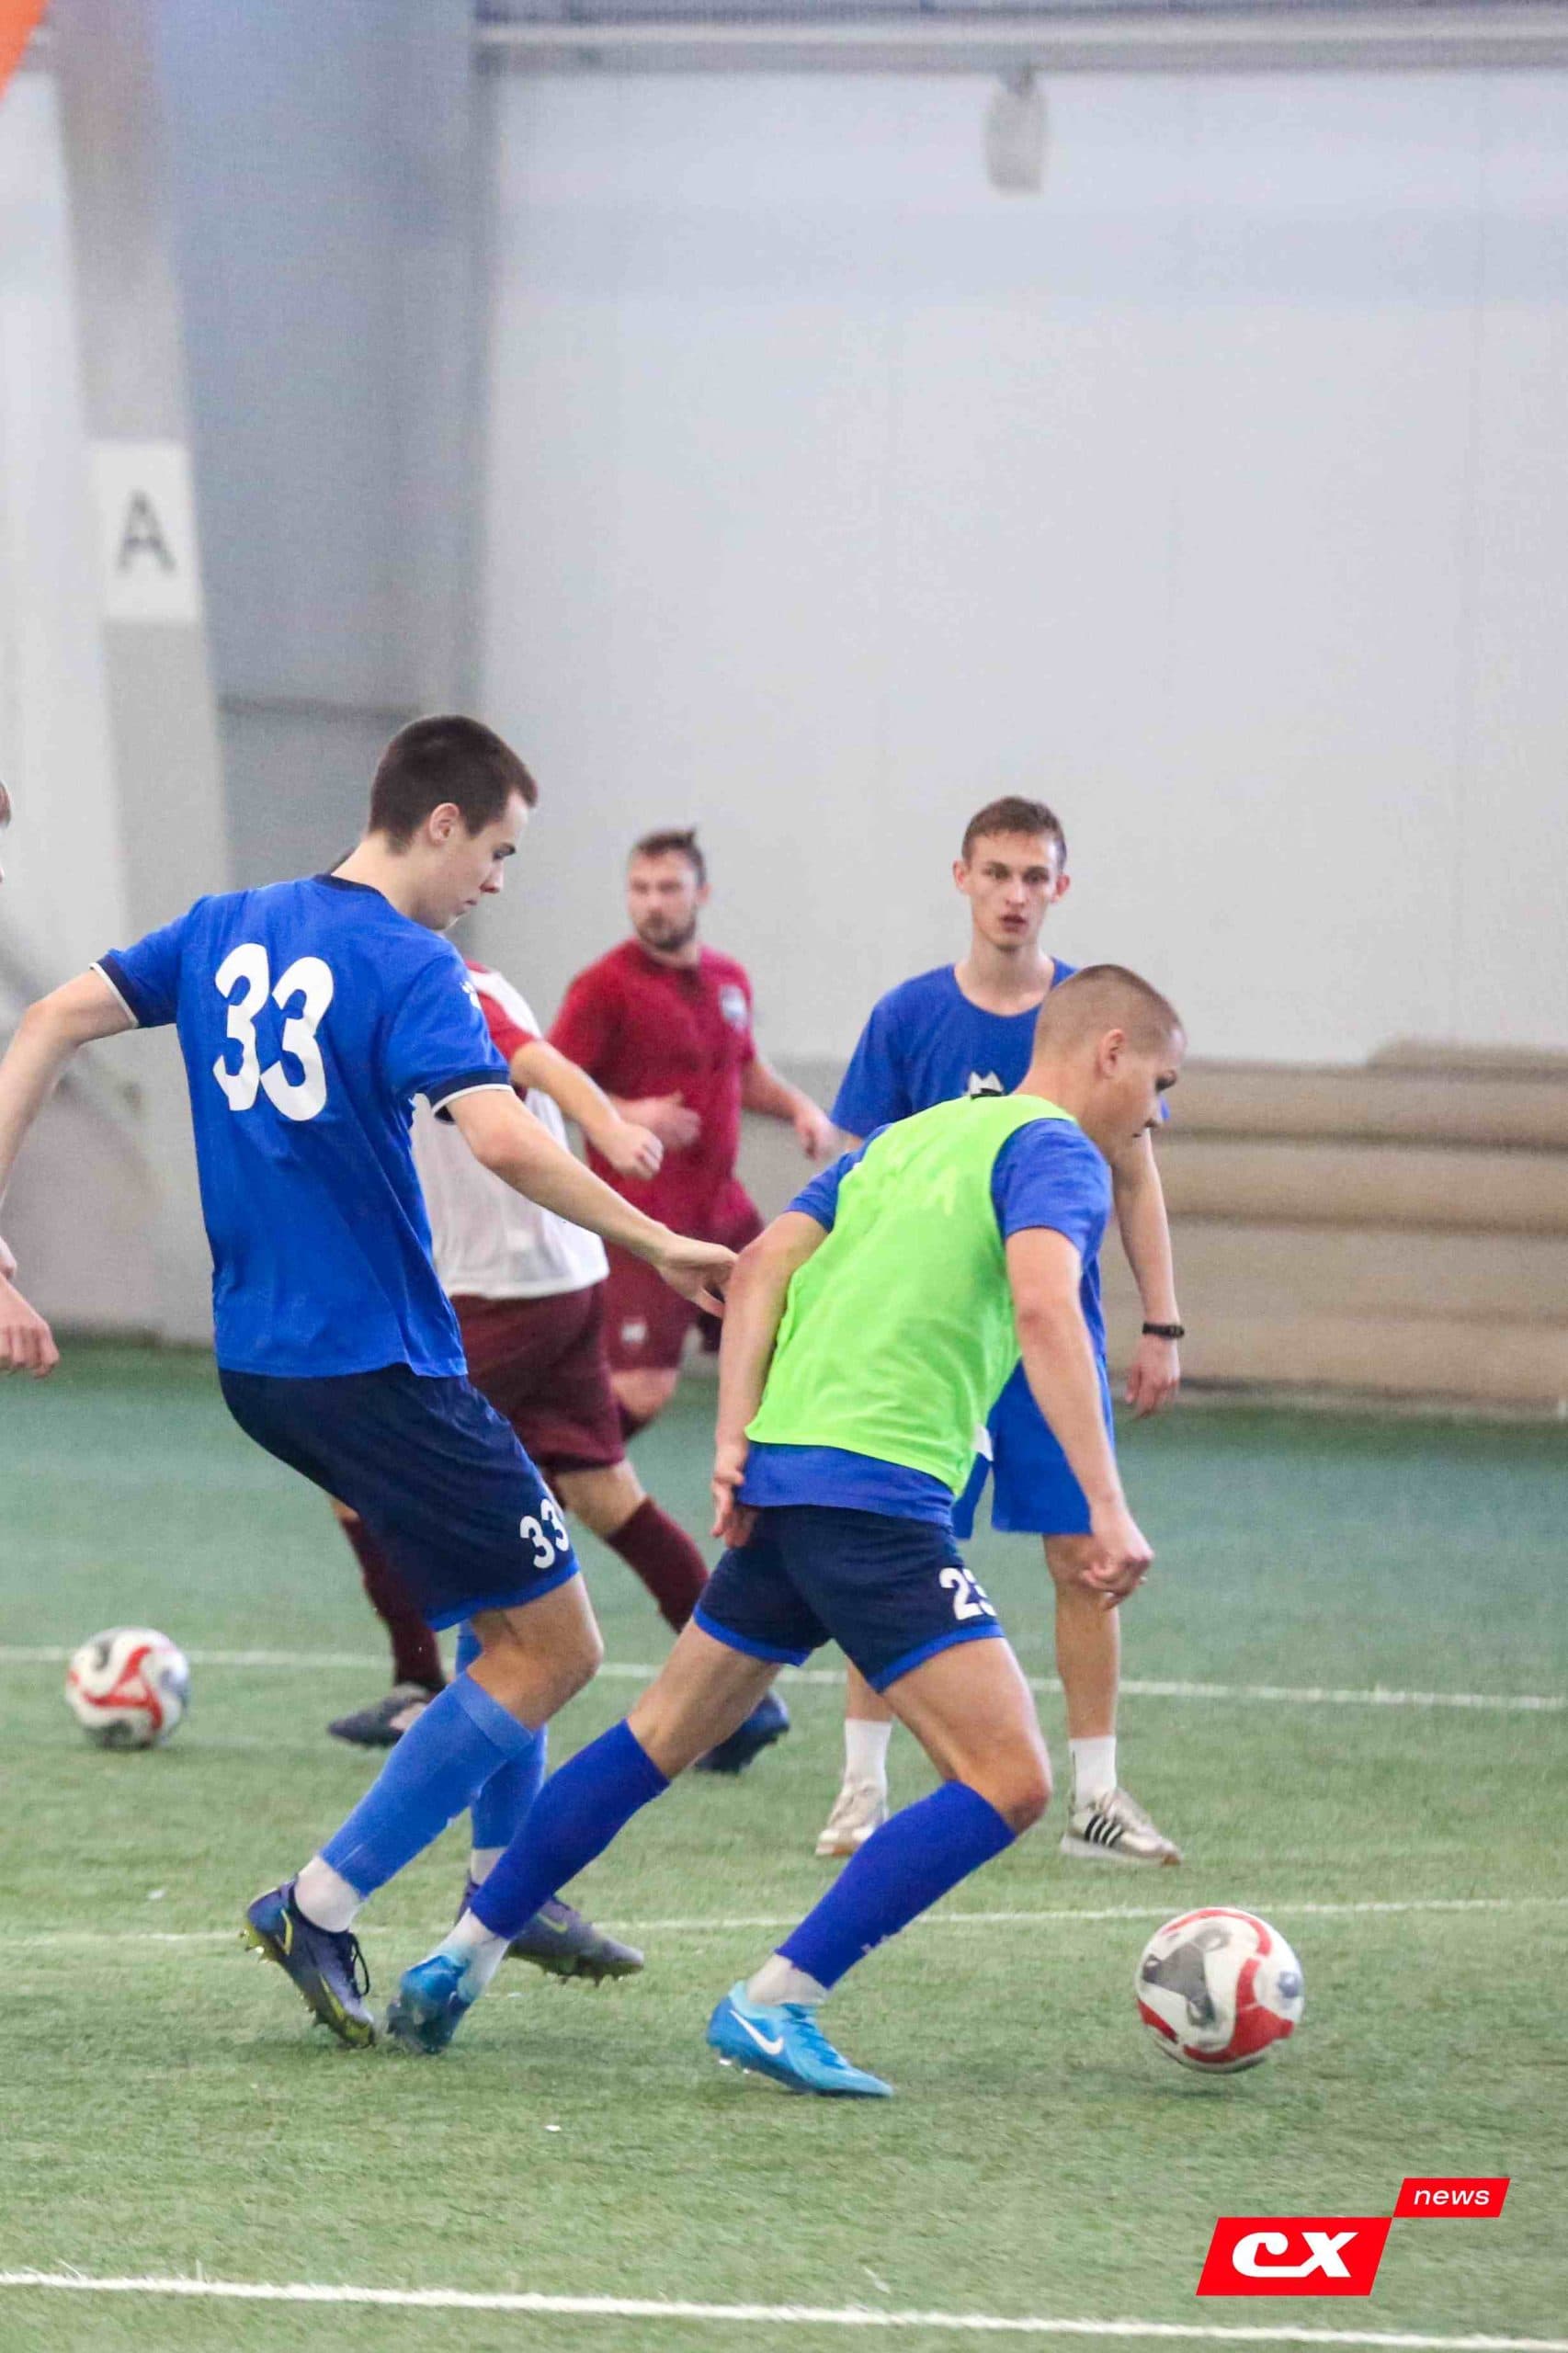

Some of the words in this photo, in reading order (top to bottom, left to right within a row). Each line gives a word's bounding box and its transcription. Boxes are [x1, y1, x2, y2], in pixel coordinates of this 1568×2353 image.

[116, 489, 176, 574] A
[212, 942, 334, 1122] 33
[519, 1498, 569, 1569] 33
